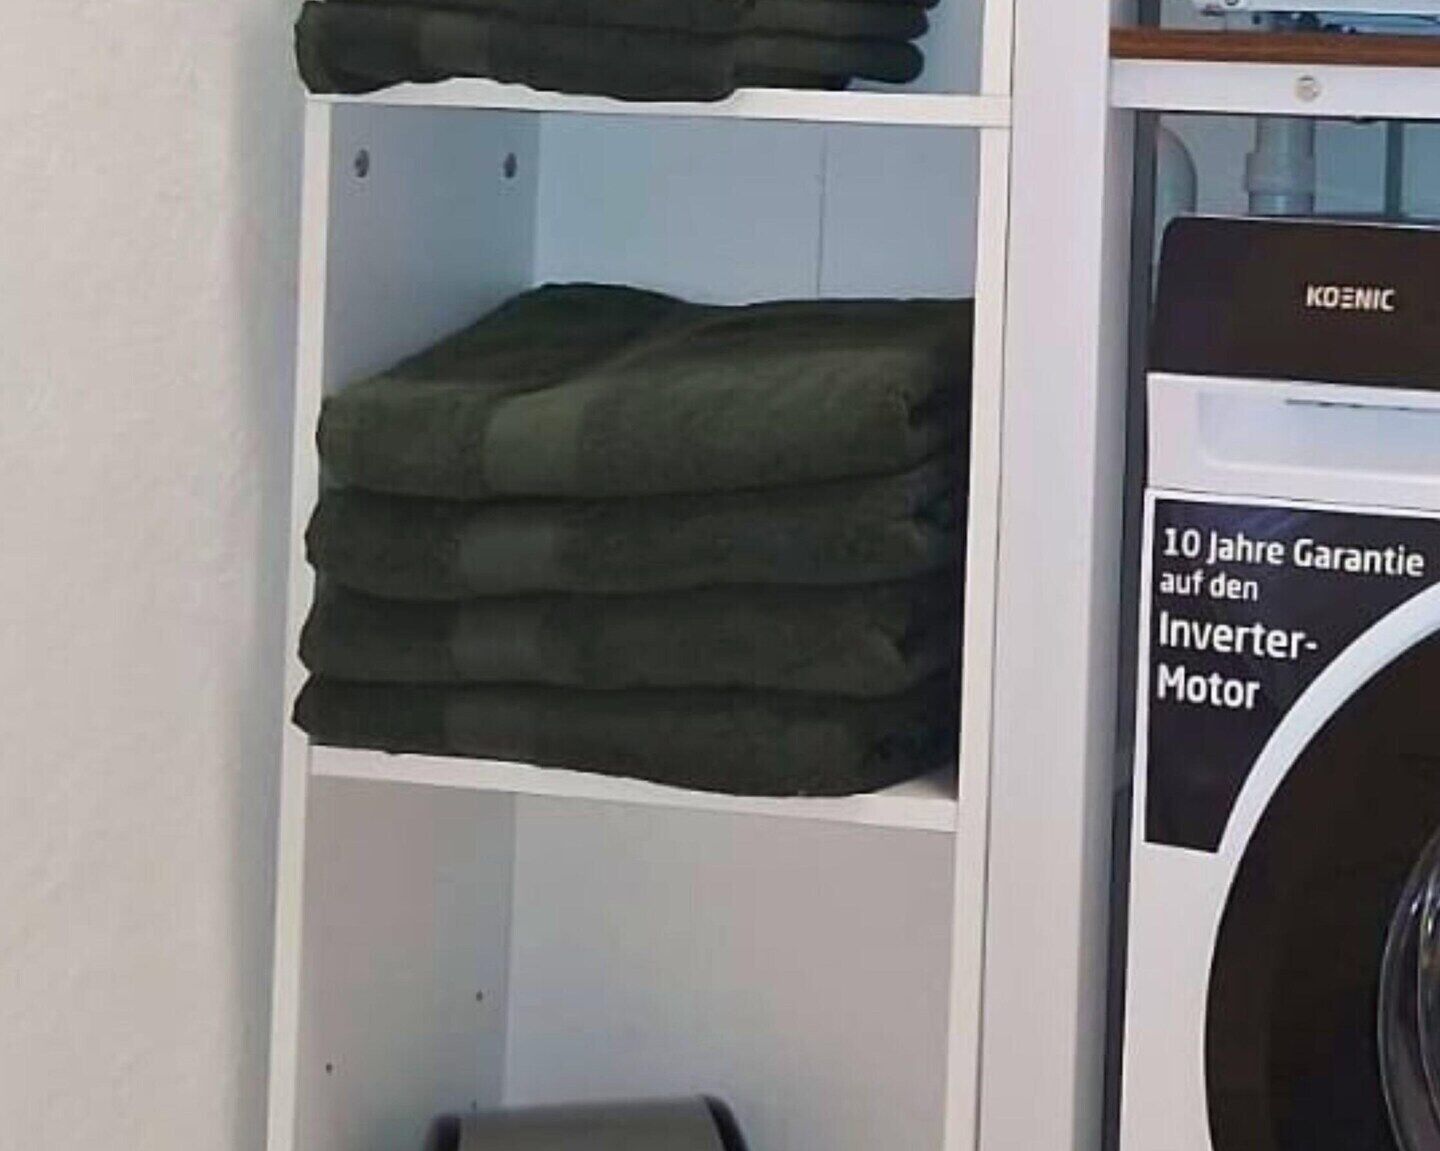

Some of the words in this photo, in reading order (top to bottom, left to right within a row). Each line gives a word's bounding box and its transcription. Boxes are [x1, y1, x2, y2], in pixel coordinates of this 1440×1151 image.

[1306, 284, 1397, 312] KOENIC
[1162, 528, 1200, 558] 10
[1206, 534, 1284, 565] Jahre
[1294, 539, 1425, 577] Garantie
[1160, 570, 1206, 595] auf
[1210, 572, 1258, 601] den
[1158, 611, 1318, 659] Inverter-
[1156, 663, 1260, 710] Motor
